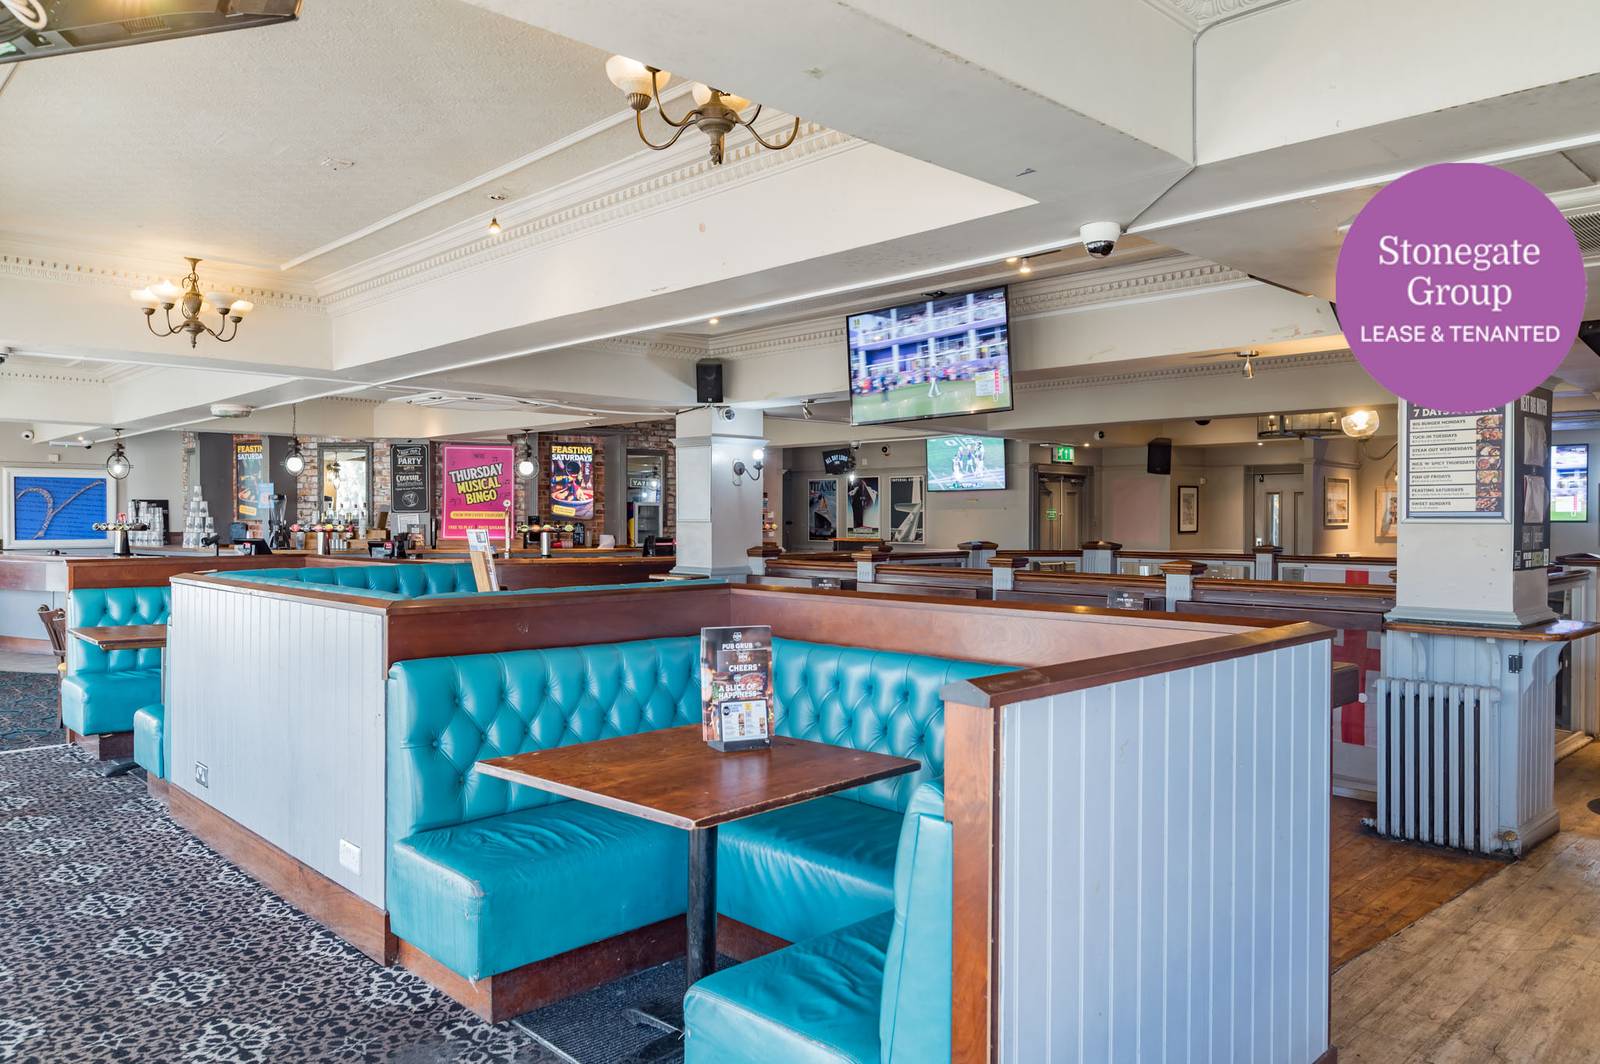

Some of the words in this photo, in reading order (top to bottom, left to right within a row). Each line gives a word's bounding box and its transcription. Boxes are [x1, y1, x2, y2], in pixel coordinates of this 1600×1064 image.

[1413, 408, 1420, 418] 7
[551, 445, 593, 454] FEASTING
[397, 457, 422, 466] PARTY
[551, 453, 593, 462] SATURDAYS
[448, 463, 503, 482] THURSDAY
[457, 477, 501, 494] MUSICAL
[809, 480, 836, 492] TITANIC
[466, 490, 497, 504] BINGO
[728, 664, 757, 672] CHEERS
[718, 691, 757, 699] HAPPINESS
